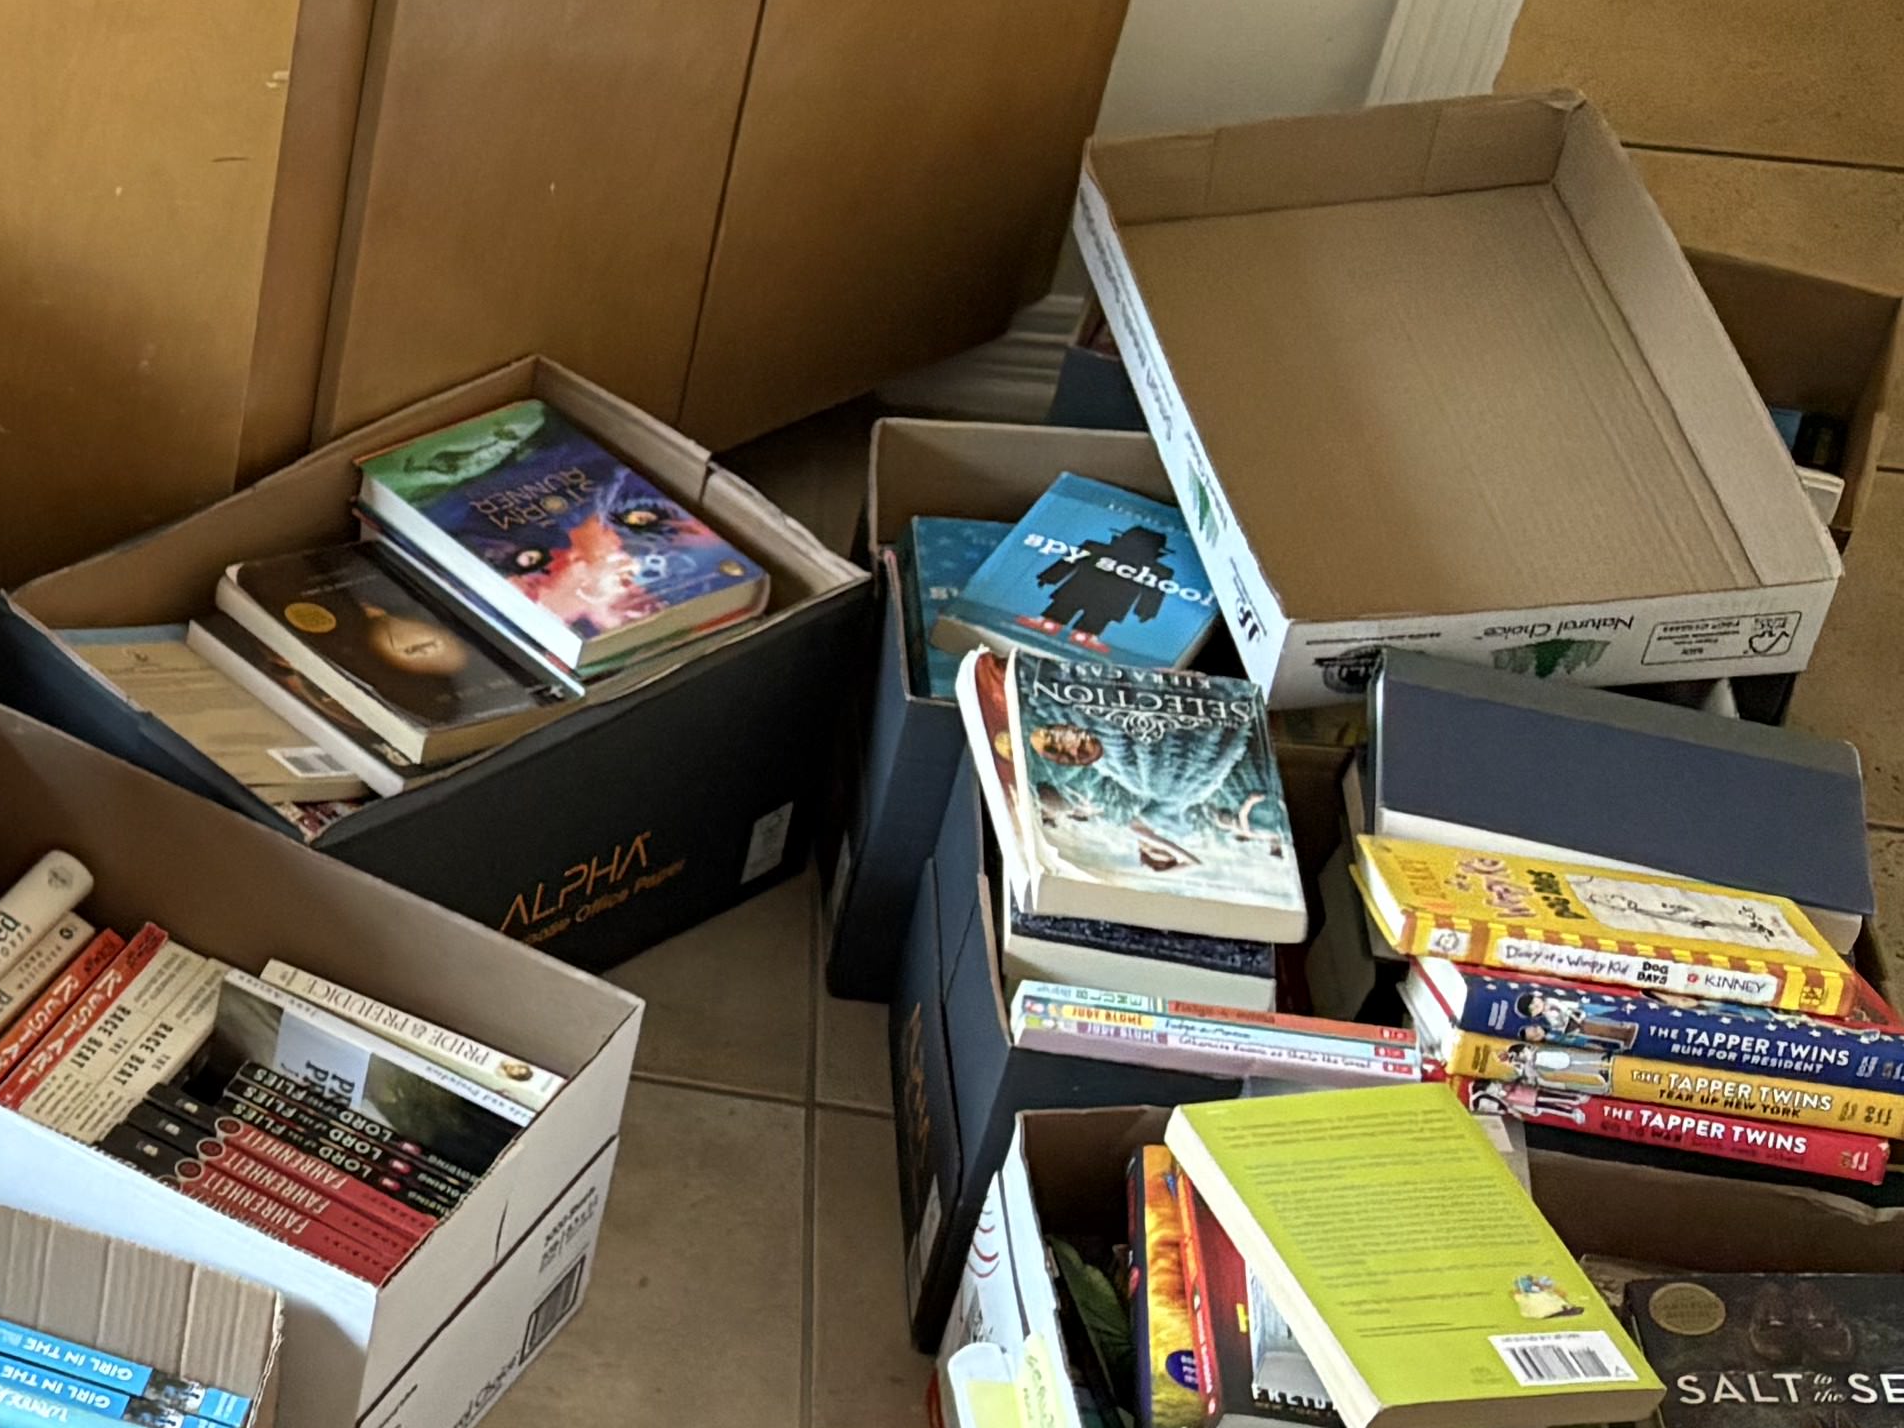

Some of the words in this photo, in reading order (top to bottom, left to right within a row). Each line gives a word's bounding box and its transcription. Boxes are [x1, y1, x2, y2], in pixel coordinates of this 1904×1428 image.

[1022, 529, 1091, 565] spy
[1094, 554, 1218, 609] school
[1482, 622, 1552, 640] Choice
[1555, 616, 1634, 637] Natural
[1058, 659, 1123, 680] CASS
[1133, 670, 1211, 690] KIERA
[1032, 658, 1252, 724] SELECTION
[500, 831, 653, 934] ALPHA
[1506, 944, 1540, 964] Diary
[1566, 953, 1607, 974] Wimpy
[1606, 958, 1631, 976] Kid
[1703, 972, 1767, 993] KINNEY
[97, 1004, 132, 1037] RACE
[307, 976, 410, 1034] PREJUDICE
[1071, 1006, 1102, 1024] JUDY
[1103, 1010, 1145, 1027] BLUME
[139, 1022, 174, 1054] RACE
[410, 1021, 428, 1042] &
[428, 1027, 490, 1068] PRIDE
[1647, 1024, 1680, 1042] THE
[1685, 1027, 1772, 1055] TAPPER
[1775, 1039, 1851, 1068] TWINS
[69, 1036, 104, 1069] BEAT
[1670, 1043, 1705, 1058] RUN
[1706, 1047, 1740, 1062] FOR
[1741, 1052, 1824, 1075] PRESIDENT
[113, 1055, 146, 1086] BEAT
[251, 1067, 307, 1104] FLIES
[241, 1085, 297, 1120] FLIES
[1630, 1068, 1663, 1086] THE
[1667, 1072, 1754, 1101] TAPPER
[1758, 1085, 1834, 1112] TWINS
[1658, 1089, 1697, 1105] TEAR
[1699, 1094, 1720, 1108] UP
[1722, 1097, 1758, 1112] NEW
[1760, 1103, 1802, 1120] YORK
[230, 1102, 286, 1139] FLIES
[338, 1108, 394, 1143] LORD
[1602, 1104, 1635, 1122] THE
[1638, 1108, 1726, 1141] TAPPER
[1730, 1125, 1808, 1155] TWINS
[238, 1130, 349, 1191] FAHRENHEIT
[318, 1143, 373, 1178] LORD
[328, 1127, 383, 1161] LORD
[221, 1155, 333, 1214] FAHRENHEIT
[200, 1170, 311, 1235] FAHRENHEIT
[24, 1336, 62, 1361] THE
[63, 1349, 86, 1368] IN
[1, 1363, 39, 1389] THE
[89, 1356, 134, 1382] GIRL
[41, 1377, 64, 1396] IN
[66, 1384, 111, 1410] GIRL
[1676, 1372, 1805, 1405] SALT
[1813, 1373, 1834, 1387] to
[1814, 1388, 1847, 1404] the
